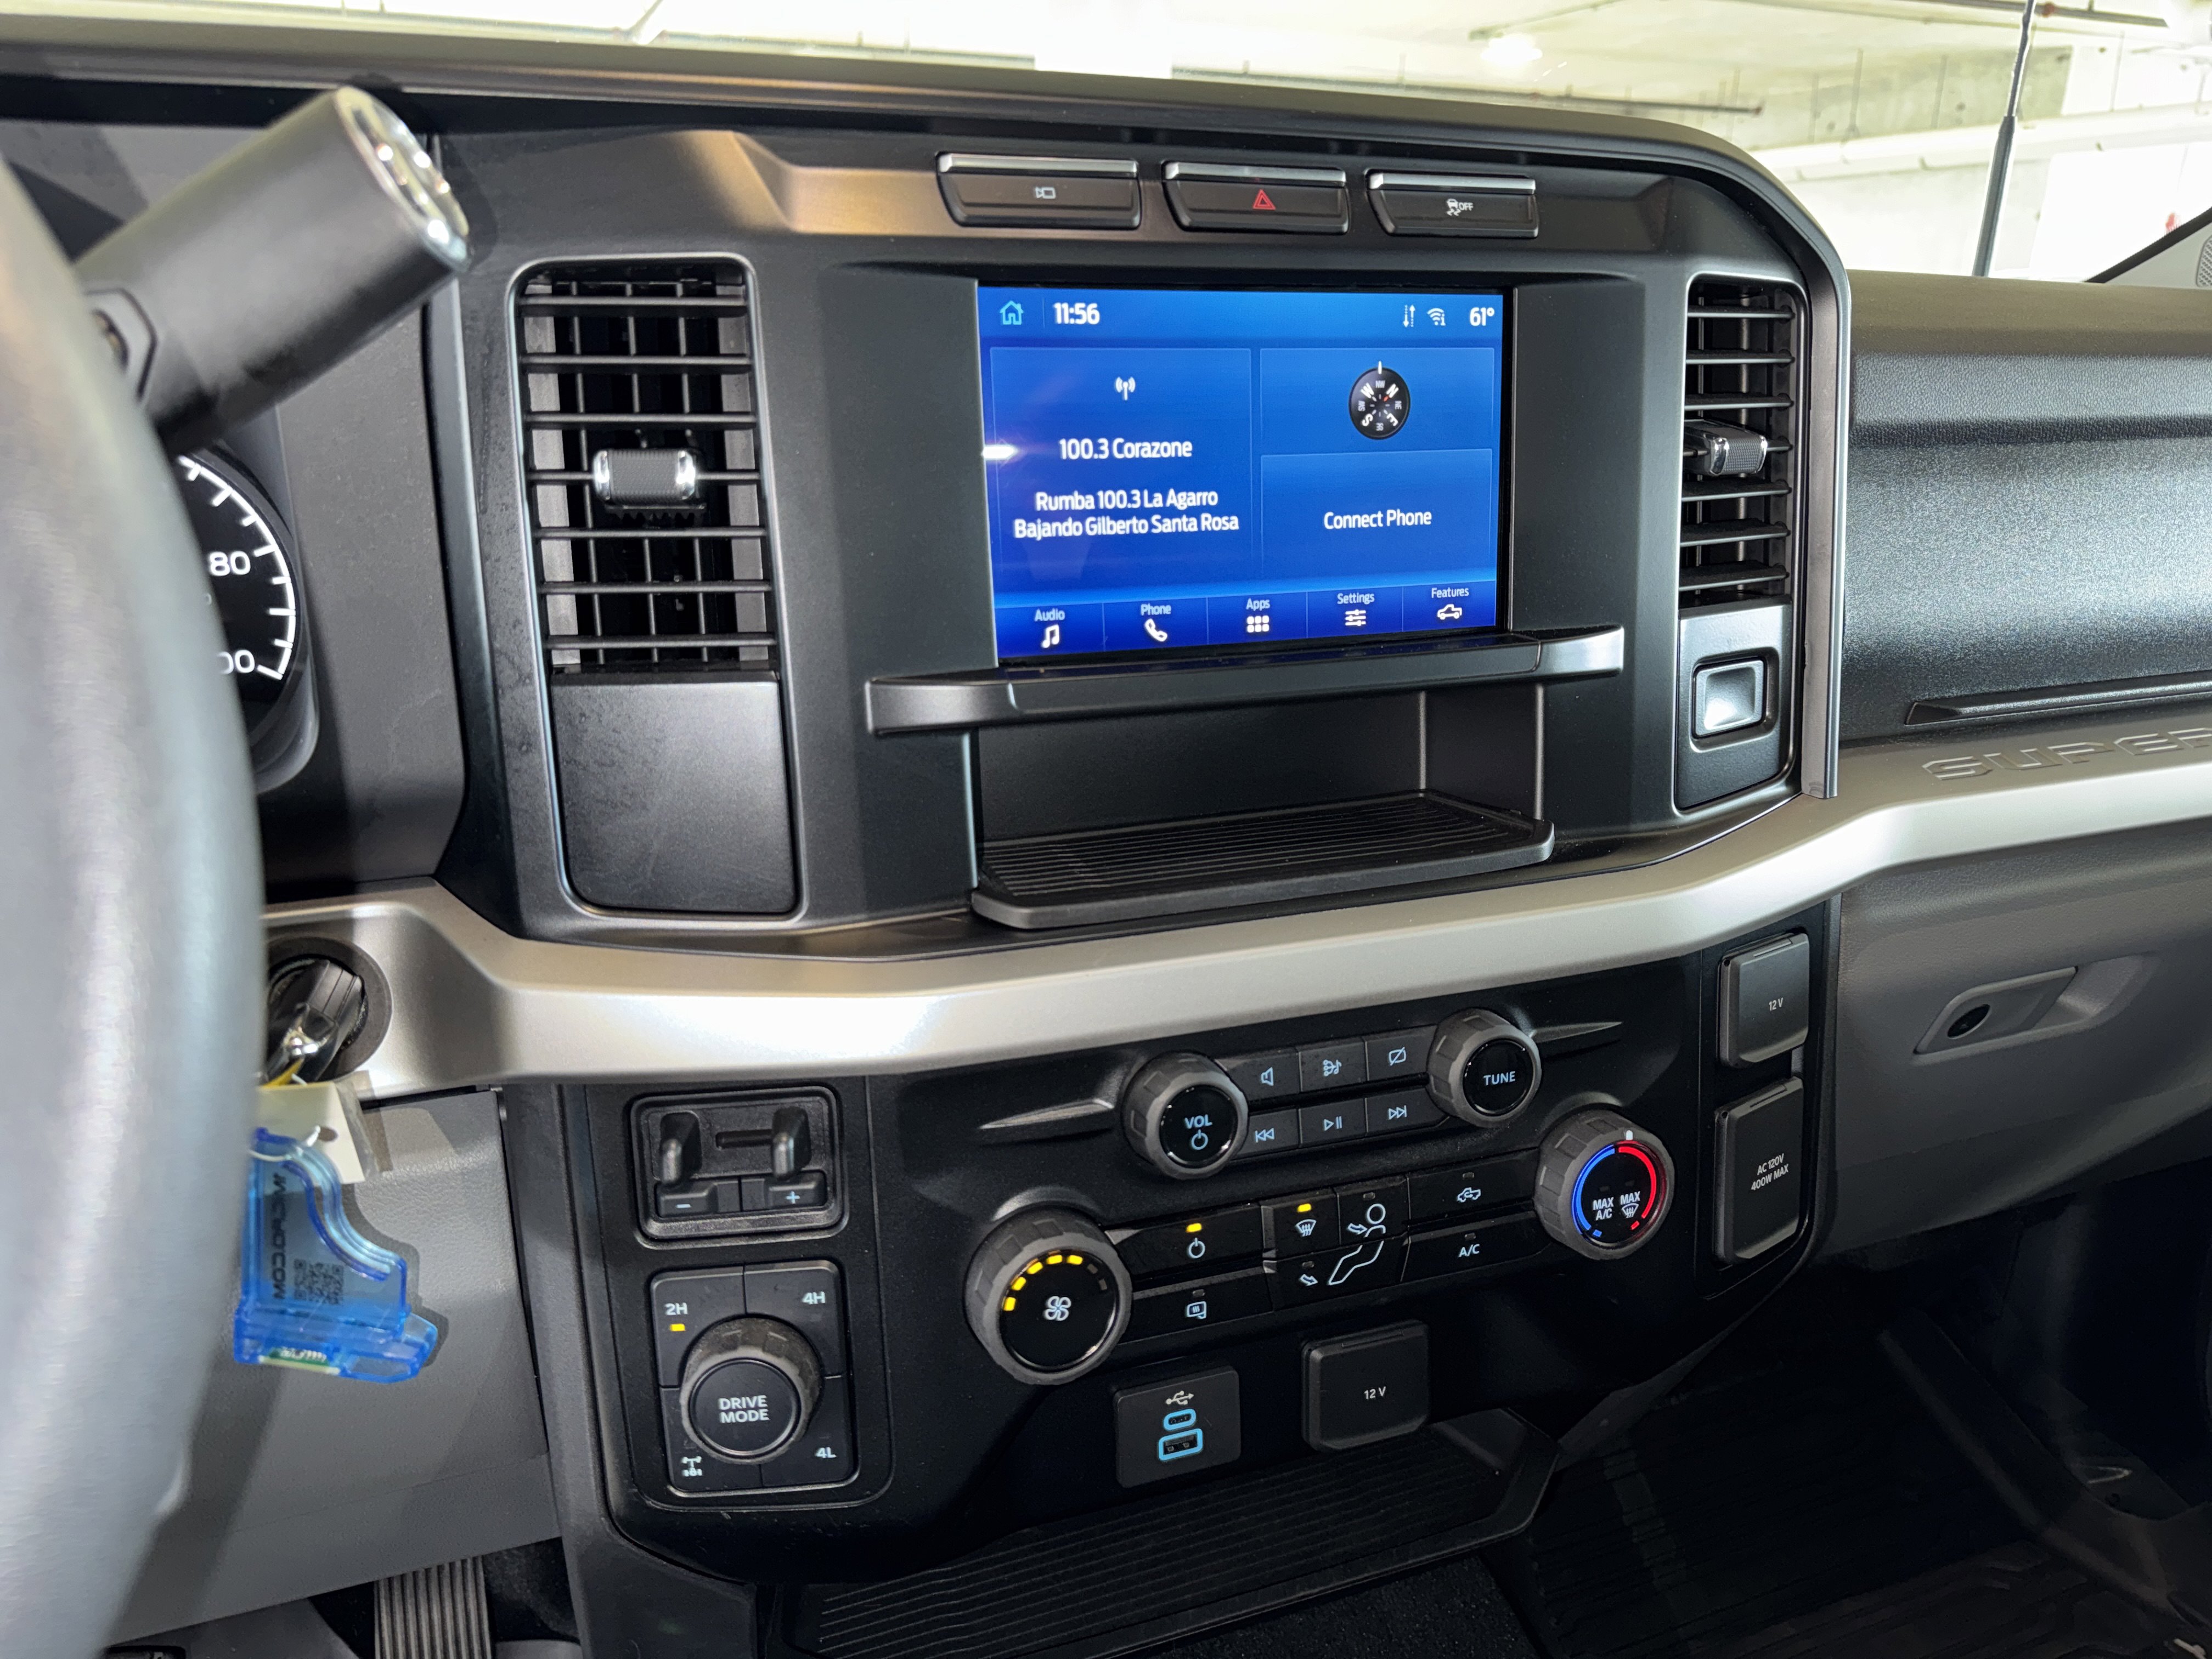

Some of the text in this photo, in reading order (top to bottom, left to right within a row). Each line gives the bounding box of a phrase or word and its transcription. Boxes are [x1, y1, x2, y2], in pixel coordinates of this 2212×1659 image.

[1459, 202, 1474, 211] OFF
[1053, 303, 1099, 325] 11:56
[1470, 307, 1495, 326] 61°
[1361, 382, 1374, 398] W
[1386, 383, 1399, 398] N
[1358, 400, 1365, 411] SW
[1395, 400, 1402, 410] NE
[1362, 414, 1373, 426] S
[1376, 422, 1384, 431] SE
[1386, 413, 1398, 426] E
[1059, 438, 1193, 460] 100.3 Corazone
[1035, 488, 1218, 511] Rumba 100.3 La Agarro
[1324, 509, 1432, 529] Connect Phone
[1014, 513, 1239, 541] Bajando Gilberto Santa Rosa
[208, 550, 251, 576] 80
[1337, 592, 1375, 605] Settings
[1431, 586, 1469, 599] Features
[1141, 603, 1171, 616] Phone
[1246, 598, 1271, 611] Apps
[1034, 608, 1065, 622] Audio
[1768, 997, 1784, 1011] 12 V
[1483, 1071, 1516, 1086] TUNE
[1184, 1115, 1212, 1128] VOL
[1757, 1153, 1785, 1176] AC 120V
[1751, 1163, 1789, 1191] 400W MAX
[1593, 1197, 1613, 1210] MAX
[1620, 1191, 1640, 1204] MAX
[1595, 1207, 1612, 1221] A/C
[1458, 1243, 1480, 1259] A/C
[802, 1291, 826, 1306] 4H
[665, 1303, 688, 1316] 2H
[1364, 1386, 1386, 1400] 12 V
[719, 1395, 768, 1410] DRIVE
[719, 1408, 769, 1424] MODE
[815, 1447, 837, 1459] 4L
